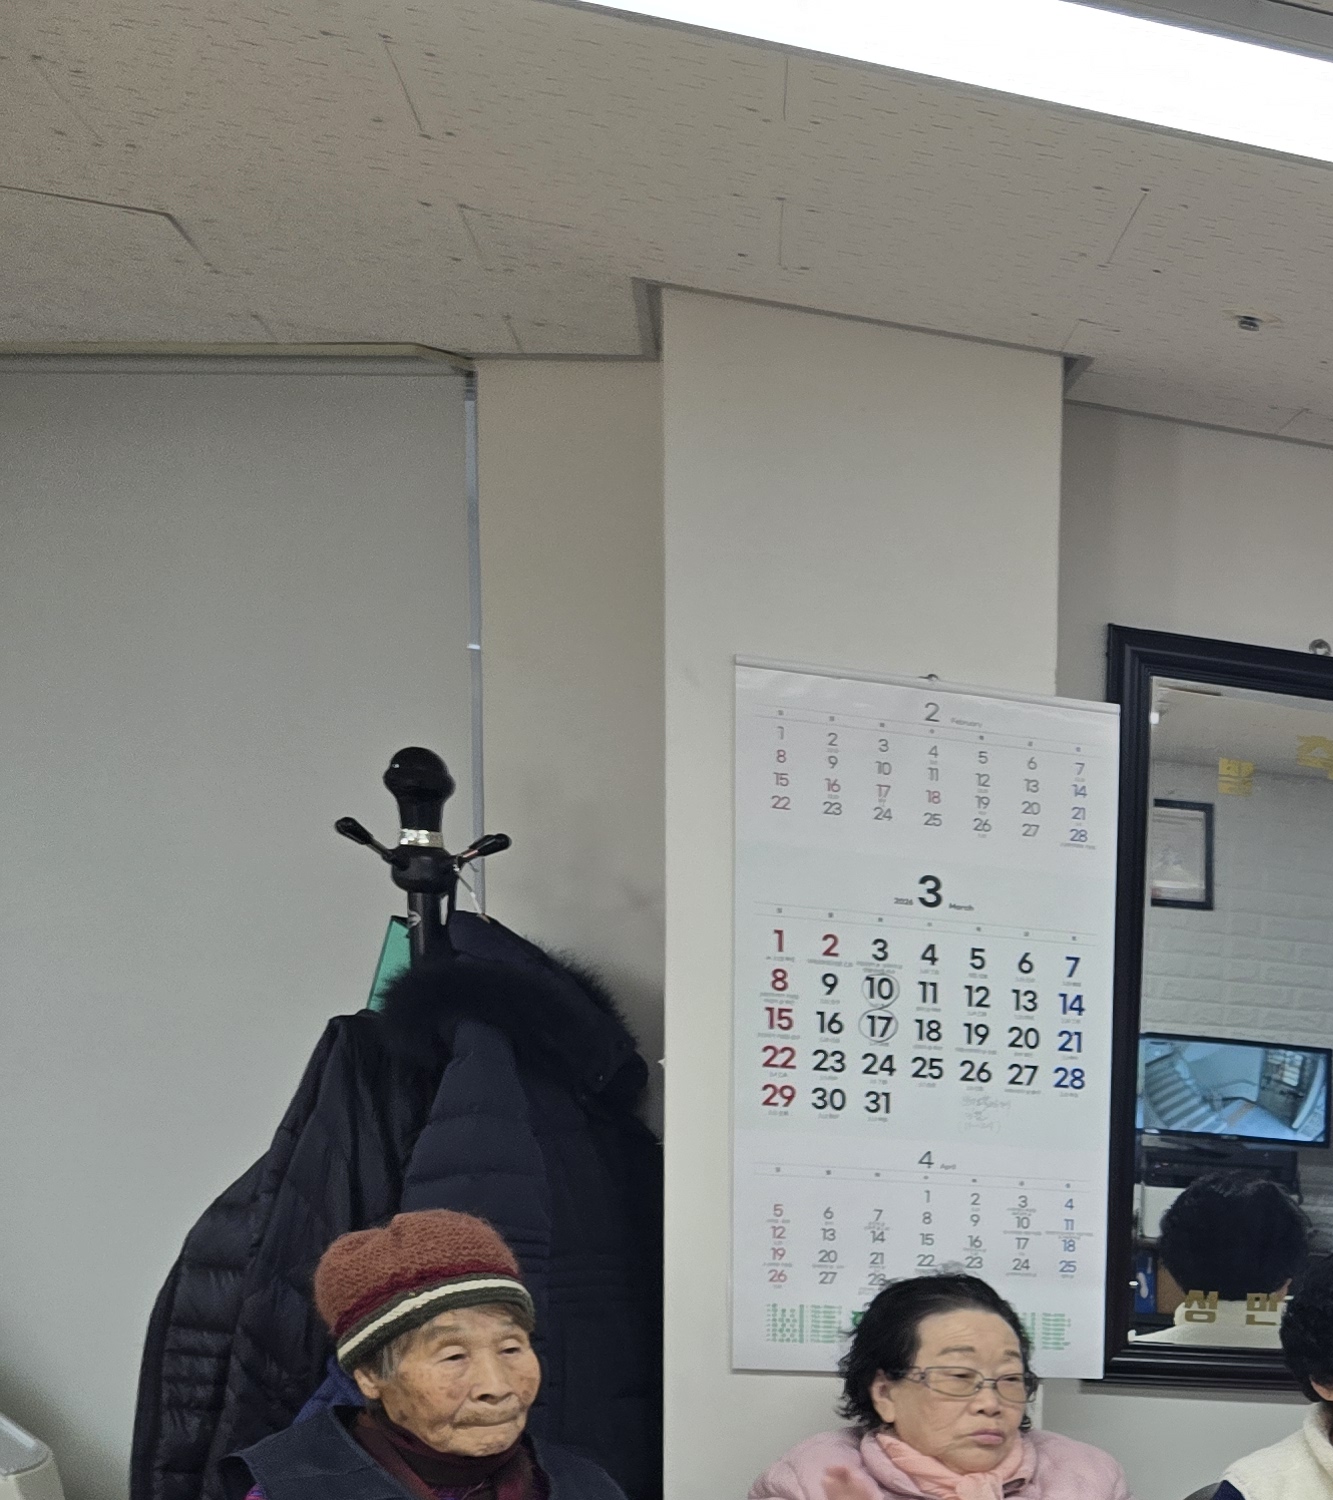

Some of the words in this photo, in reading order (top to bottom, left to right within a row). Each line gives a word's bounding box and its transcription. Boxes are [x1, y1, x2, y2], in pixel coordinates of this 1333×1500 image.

[923, 702, 941, 722] 2
[777, 726, 785, 741] 1
[827, 732, 839, 747] 2
[878, 739, 890, 753] 3
[928, 745, 940, 759] 4
[977, 751, 989, 765] 5
[1027, 757, 1038, 771] 6
[1074, 762, 1086, 775] 7
[776, 749, 787, 763] 8
[827, 756, 839, 769] 9
[875, 761, 893, 776] 10
[927, 767, 940, 782] 11
[974, 773, 991, 788] 12
[1024, 779, 1040, 794] 13
[1071, 784, 1088, 798] 14
[773, 772, 790, 787] 15
[825, 778, 842, 793] 16
[875, 784, 892, 798] 17
[925, 790, 942, 805] 18
[974, 796, 991, 810] 19
[1021, 801, 1041, 815] 20
[1071, 807, 1086, 821] 21
[771, 796, 791, 811] 22
[822, 802, 843, 816] 23
[873, 807, 893, 821] 24
[923, 812, 942, 827] 25
[973, 818, 992, 833] 26
[1022, 824, 1040, 837] 27
[1069, 829, 1088, 843] 28
[918, 875, 942, 907] 3
[949, 903, 974, 911] March
[773, 929, 784, 952] 1
[821, 933, 839, 957] 2
[871, 938, 889, 962] 3
[921, 944, 939, 966] 4
[970, 947, 985, 970] 5
[1017, 952, 1034, 974] 6
[1065, 956, 1081, 978] 7
[771, 968, 789, 992] 8
[821, 972, 838, 996] 9
[865, 976, 894, 1000] 10
[918, 981, 937, 1003] 11
[964, 985, 991, 1008] 12
[1011, 989, 1038, 1012] 13
[1058, 993, 1085, 1016] 14
[765, 1006, 794, 1031] 15
[816, 1011, 843, 1035] 16
[867, 1015, 893, 1038] 17
[915, 1019, 942, 1042] 18
[963, 1023, 990, 1045] 19
[1007, 1026, 1040, 1049] 20
[1057, 1030, 1082, 1053] 21
[762, 1045, 796, 1070] 22
[812, 1049, 846, 1073] 23
[862, 1053, 896, 1076] 24
[911, 1056, 943, 1079] 25
[959, 1060, 992, 1083] 26
[1007, 1063, 1039, 1086] 27
[1053, 1067, 1085, 1089] 28
[762, 1083, 796, 1107] 29
[811, 1087, 846, 1111] 30
[865, 1090, 891, 1114] 31
[918, 1151, 934, 1169] 4
[773, 1203, 784, 1217] 5
[823, 1207, 834, 1220] 6
[873, 1208, 883, 1221] 7
[922, 1211, 932, 1225] 8
[970, 1214, 980, 1227] 9
[1015, 1216, 1031, 1229] 10
[1064, 1218, 1074, 1231] 11
[925, 1190, 930, 1203] 1
[971, 1193, 981, 1205] 2
[1018, 1195, 1028, 1208] 3
[1064, 1198, 1074, 1210] 4
[771, 1225, 786, 1240] 12
[821, 1228, 836, 1242] 13
[870, 1230, 886, 1243] 14
[919, 1232, 935, 1246] 15
[967, 1235, 983, 1248] 16
[1015, 1237, 1030, 1250] 17
[1062, 1239, 1076, 1252] 18
[768, 1269, 788, 1283] 26
[819, 1271, 837, 1285] 27
[771, 1247, 786, 1261] 19
[818, 1250, 838, 1263] 20
[869, 1252, 884, 1265] 21
[917, 1254, 935, 1267] 22
[965, 1256, 983, 1269] 23
[1012, 1258, 1031, 1271] 24
[1059, 1260, 1077, 1273] 25
